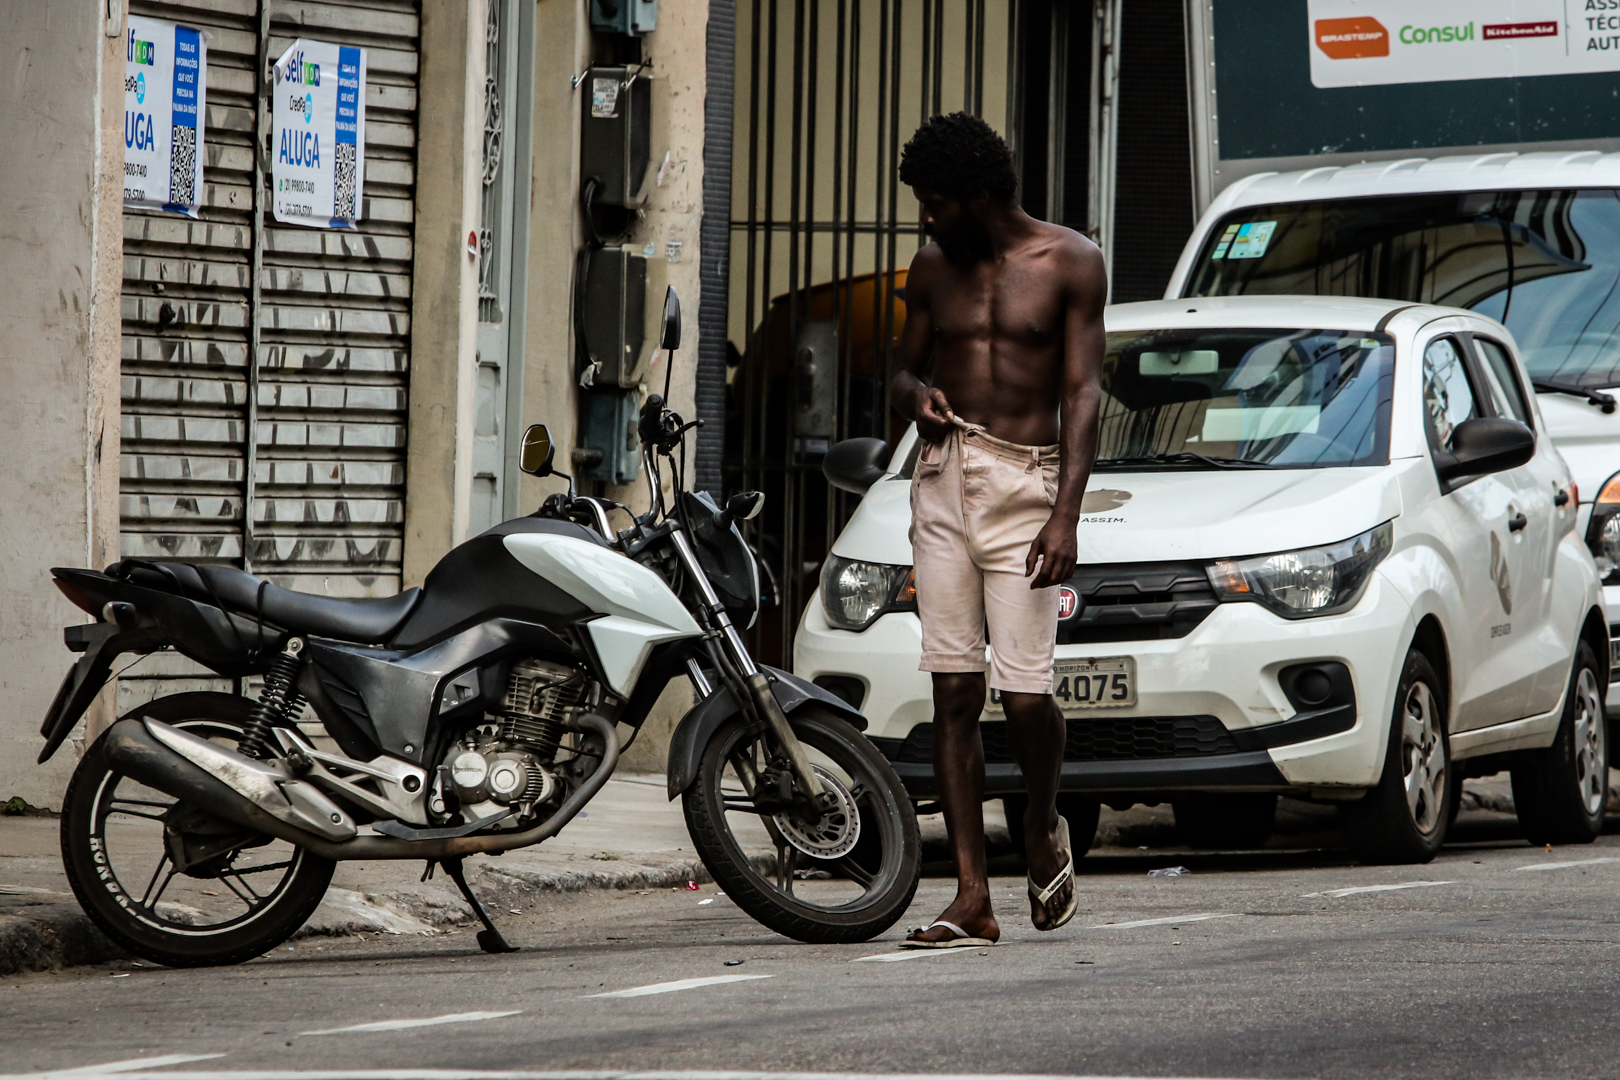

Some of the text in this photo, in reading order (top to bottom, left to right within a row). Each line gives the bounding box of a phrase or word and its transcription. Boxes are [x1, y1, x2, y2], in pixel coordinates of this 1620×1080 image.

[1320, 31, 1383, 43] BRASTEMP
[1399, 21, 1474, 45] Consul
[1486, 25, 1554, 38] KitchenAid
[285, 50, 304, 84] Self
[289, 94, 312, 119] CredPago
[124, 110, 154, 152] UGA
[279, 127, 321, 169] ALUGA
[1059, 596, 1072, 612] AT
[1055, 673, 1128, 703] 4075
[89, 837, 130, 909] HONDA
